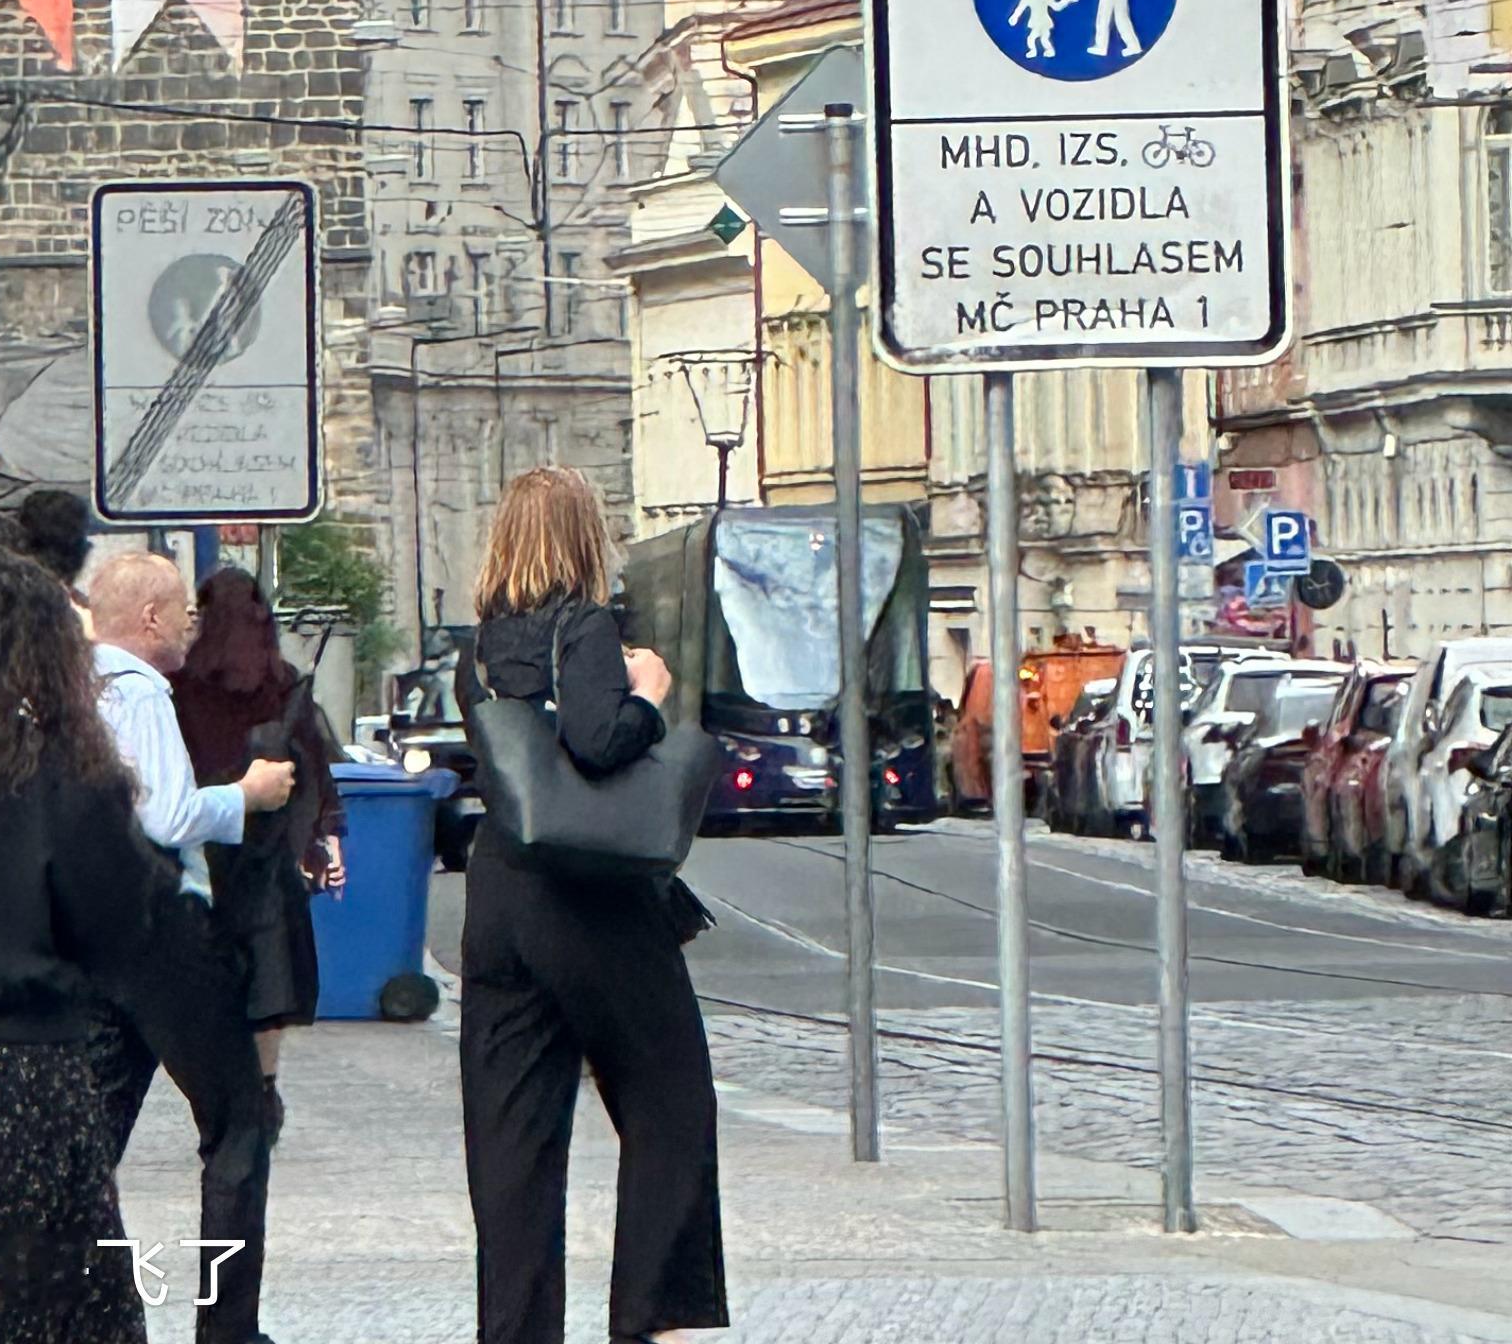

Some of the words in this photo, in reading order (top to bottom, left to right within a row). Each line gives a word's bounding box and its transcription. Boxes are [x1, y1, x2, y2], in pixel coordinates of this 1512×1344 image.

[970, 190, 996, 224] A
[1020, 185, 1190, 222] VOZIDLA
[920, 246, 970, 279] SE
[992, 240, 1244, 278] SOUHLASEM
[957, 292, 1015, 334] MČ
[1035, 296, 1175, 331] PRAHA
[1197, 295, 1209, 328] 1
[1179, 510, 1204, 543] P
[1271, 516, 1300, 554] P
